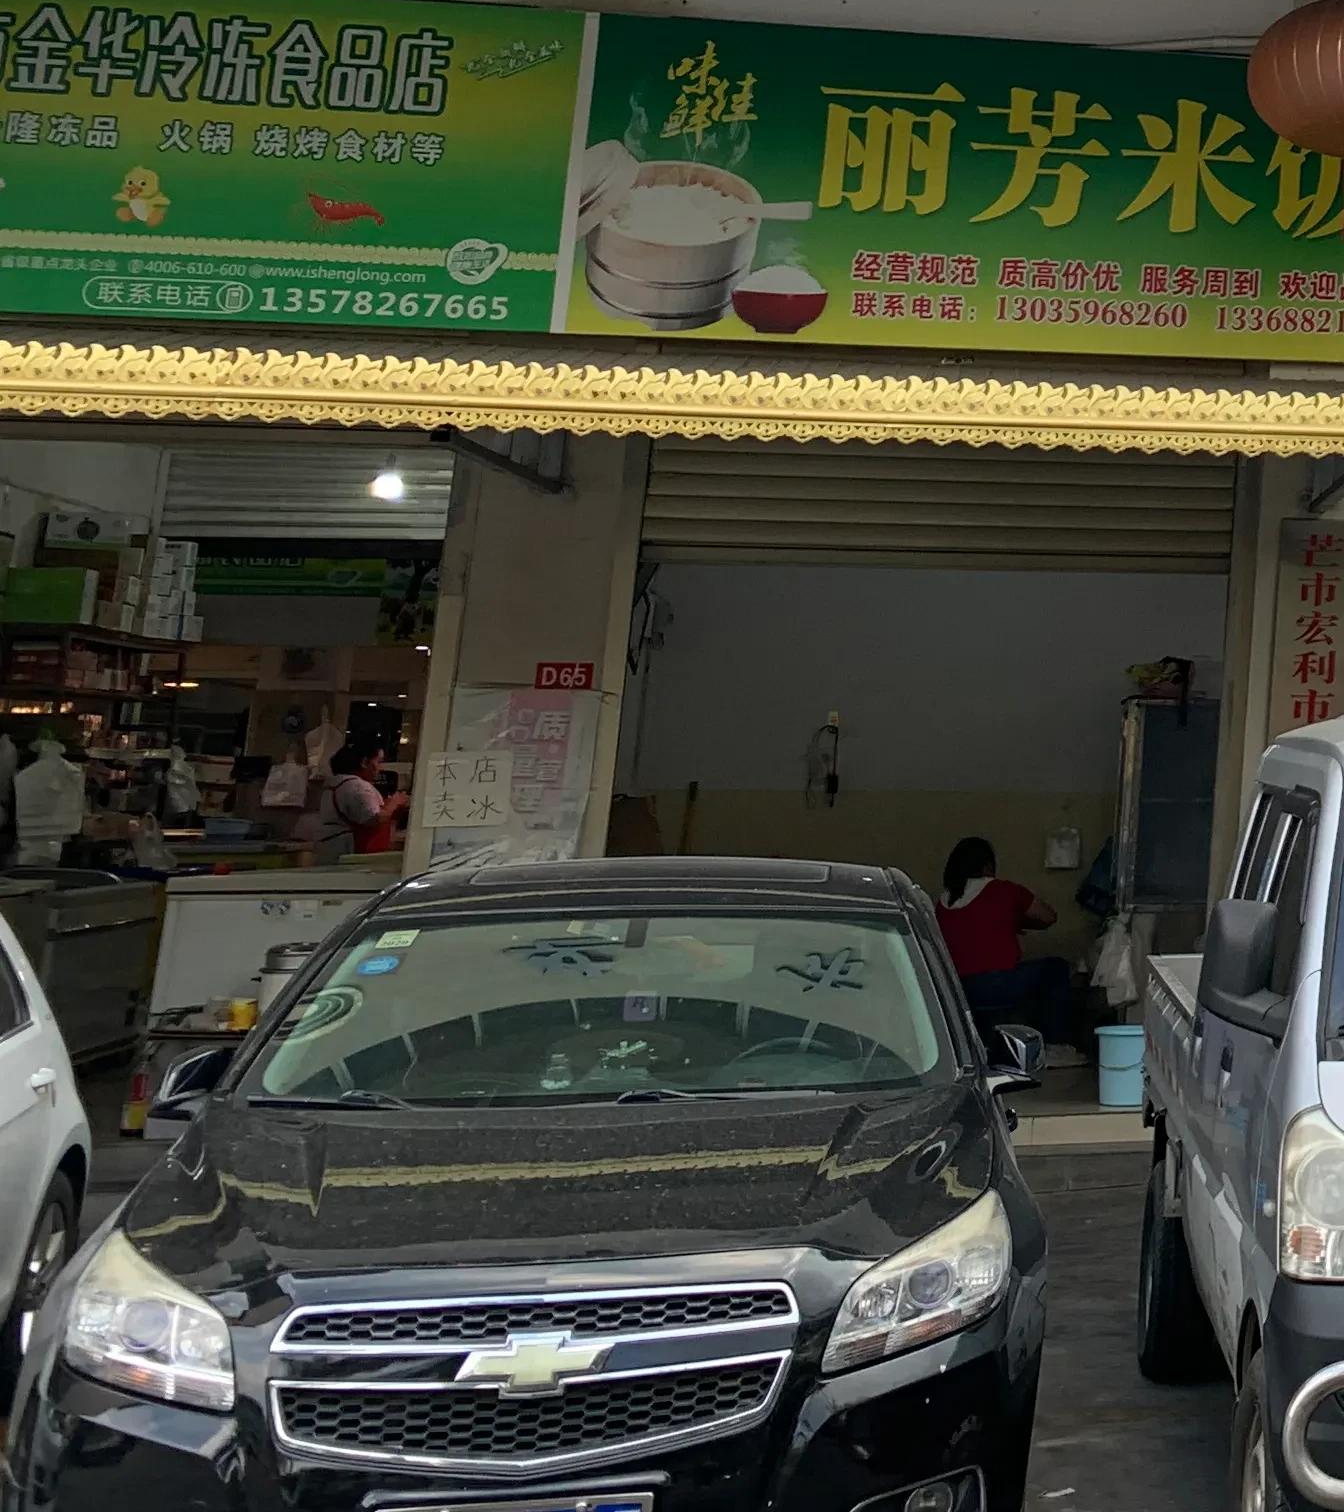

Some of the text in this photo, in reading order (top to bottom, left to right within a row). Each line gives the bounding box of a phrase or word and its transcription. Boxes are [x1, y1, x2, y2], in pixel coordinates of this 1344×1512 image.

[0, 6, 451, 114] 金华冷冻食品店
[158, 120, 235, 155] 火锅
[254, 123, 446, 165] 烧烤食材等
[265, 264, 426, 285] www.ishenglong.com
[851, 250, 980, 287] 经营规范
[998, 258, 1121, 293] 质高价优
[1140, 264, 1262, 299] 服务周到
[96, 280, 509, 320] 联系电话 13578267665
[995, 295, 1188, 330] 13035968260
[541, 667, 588, 686] D65
[435, 756, 497, 788] 本店
[433, 791, 502, 821] 卖冰
